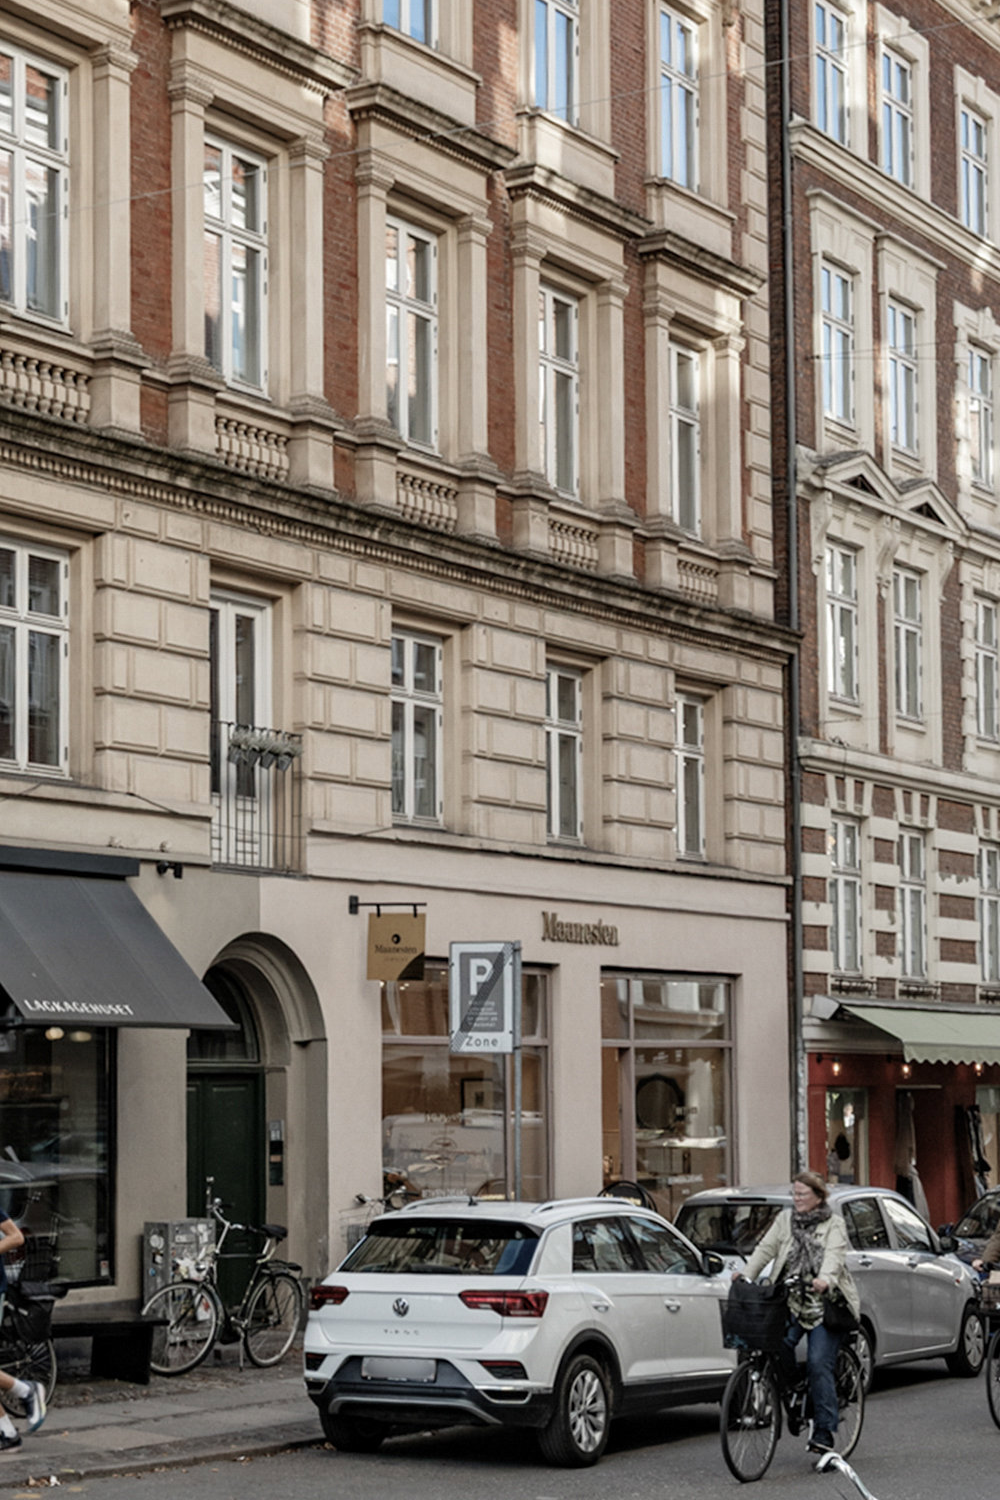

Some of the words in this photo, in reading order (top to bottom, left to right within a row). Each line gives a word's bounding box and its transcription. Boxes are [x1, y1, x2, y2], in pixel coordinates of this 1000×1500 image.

[541, 911, 618, 946] Maanesten
[469, 958, 494, 995] P
[24, 999, 134, 1016] LAGKAGEHUSET
[465, 1036, 499, 1047] Zone
